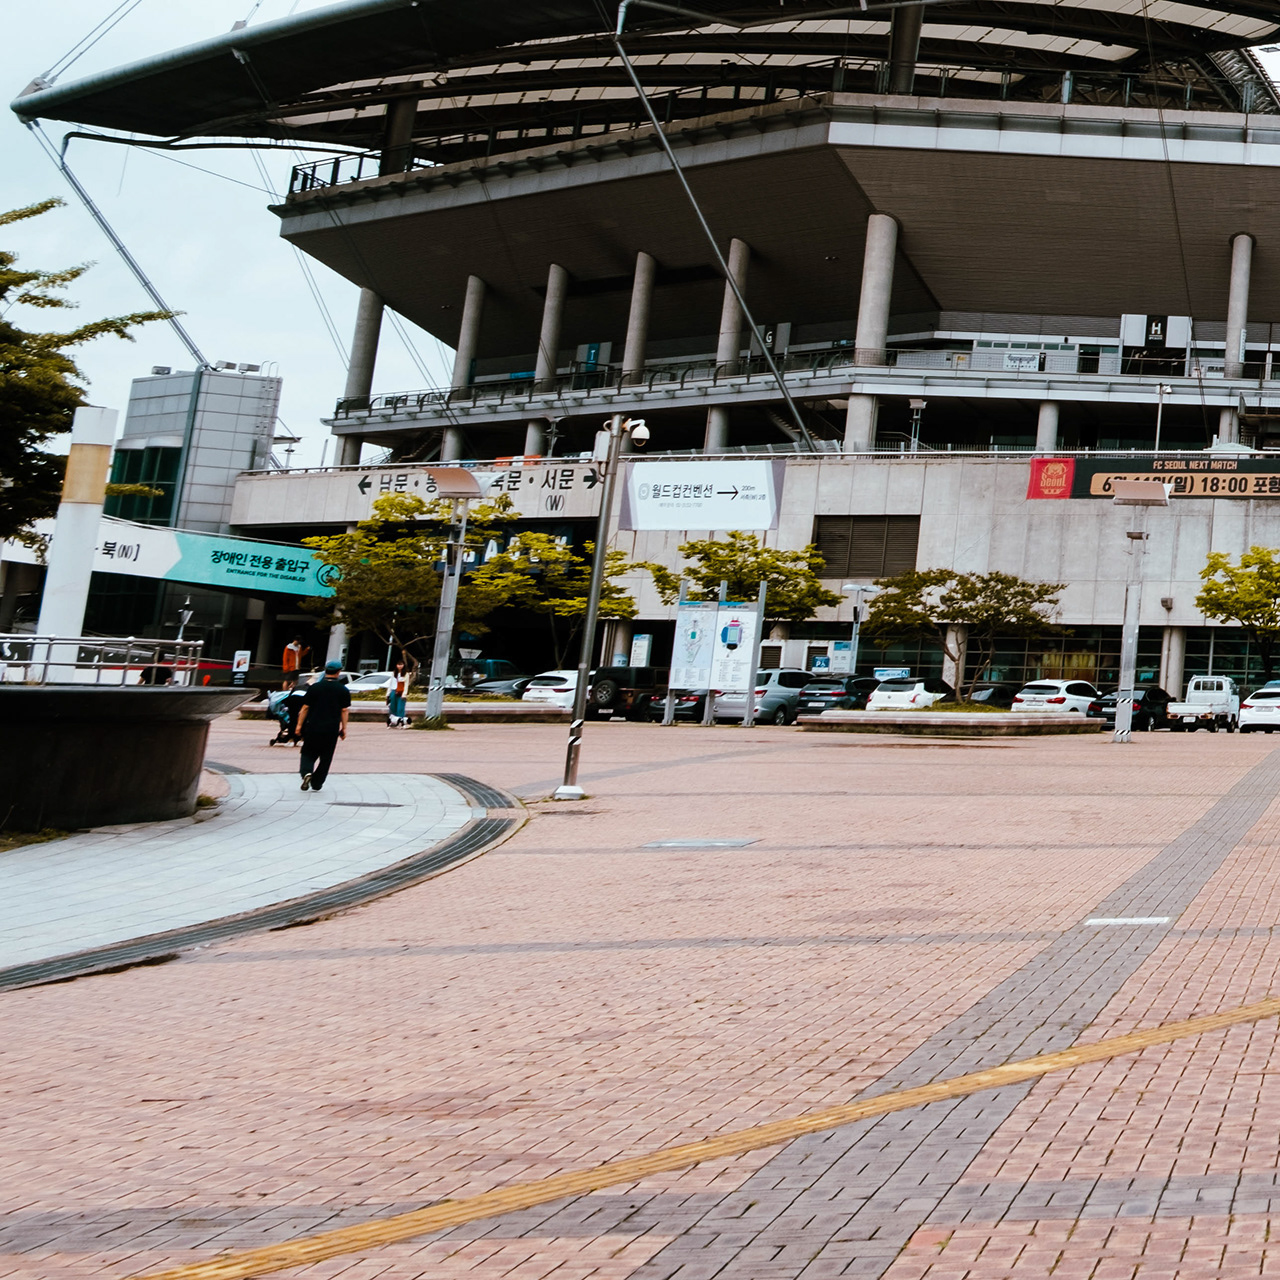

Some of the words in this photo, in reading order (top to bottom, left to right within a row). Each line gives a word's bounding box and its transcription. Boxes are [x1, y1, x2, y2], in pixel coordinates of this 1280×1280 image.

[1151, 322, 1162, 335] H
[765, 331, 773, 343] G
[1153, 461, 1163, 470] FC
[1164, 461, 1187, 470] SEOUL
[1189, 461, 1209, 470] NEXT
[1211, 461, 1238, 470] MATCH
[541, 469, 575, 490] 서문
[1201, 476, 1248, 493] 18:00
[652, 484, 713, 499] 월드컵컨벤션
[211, 550, 248, 566] 장애인
[249, 554, 273, 569] 전용
[275, 558, 309, 573] 출입구
[226, 568, 255, 577] ENTRANCE
[280, 574, 306, 582] DISABLED
